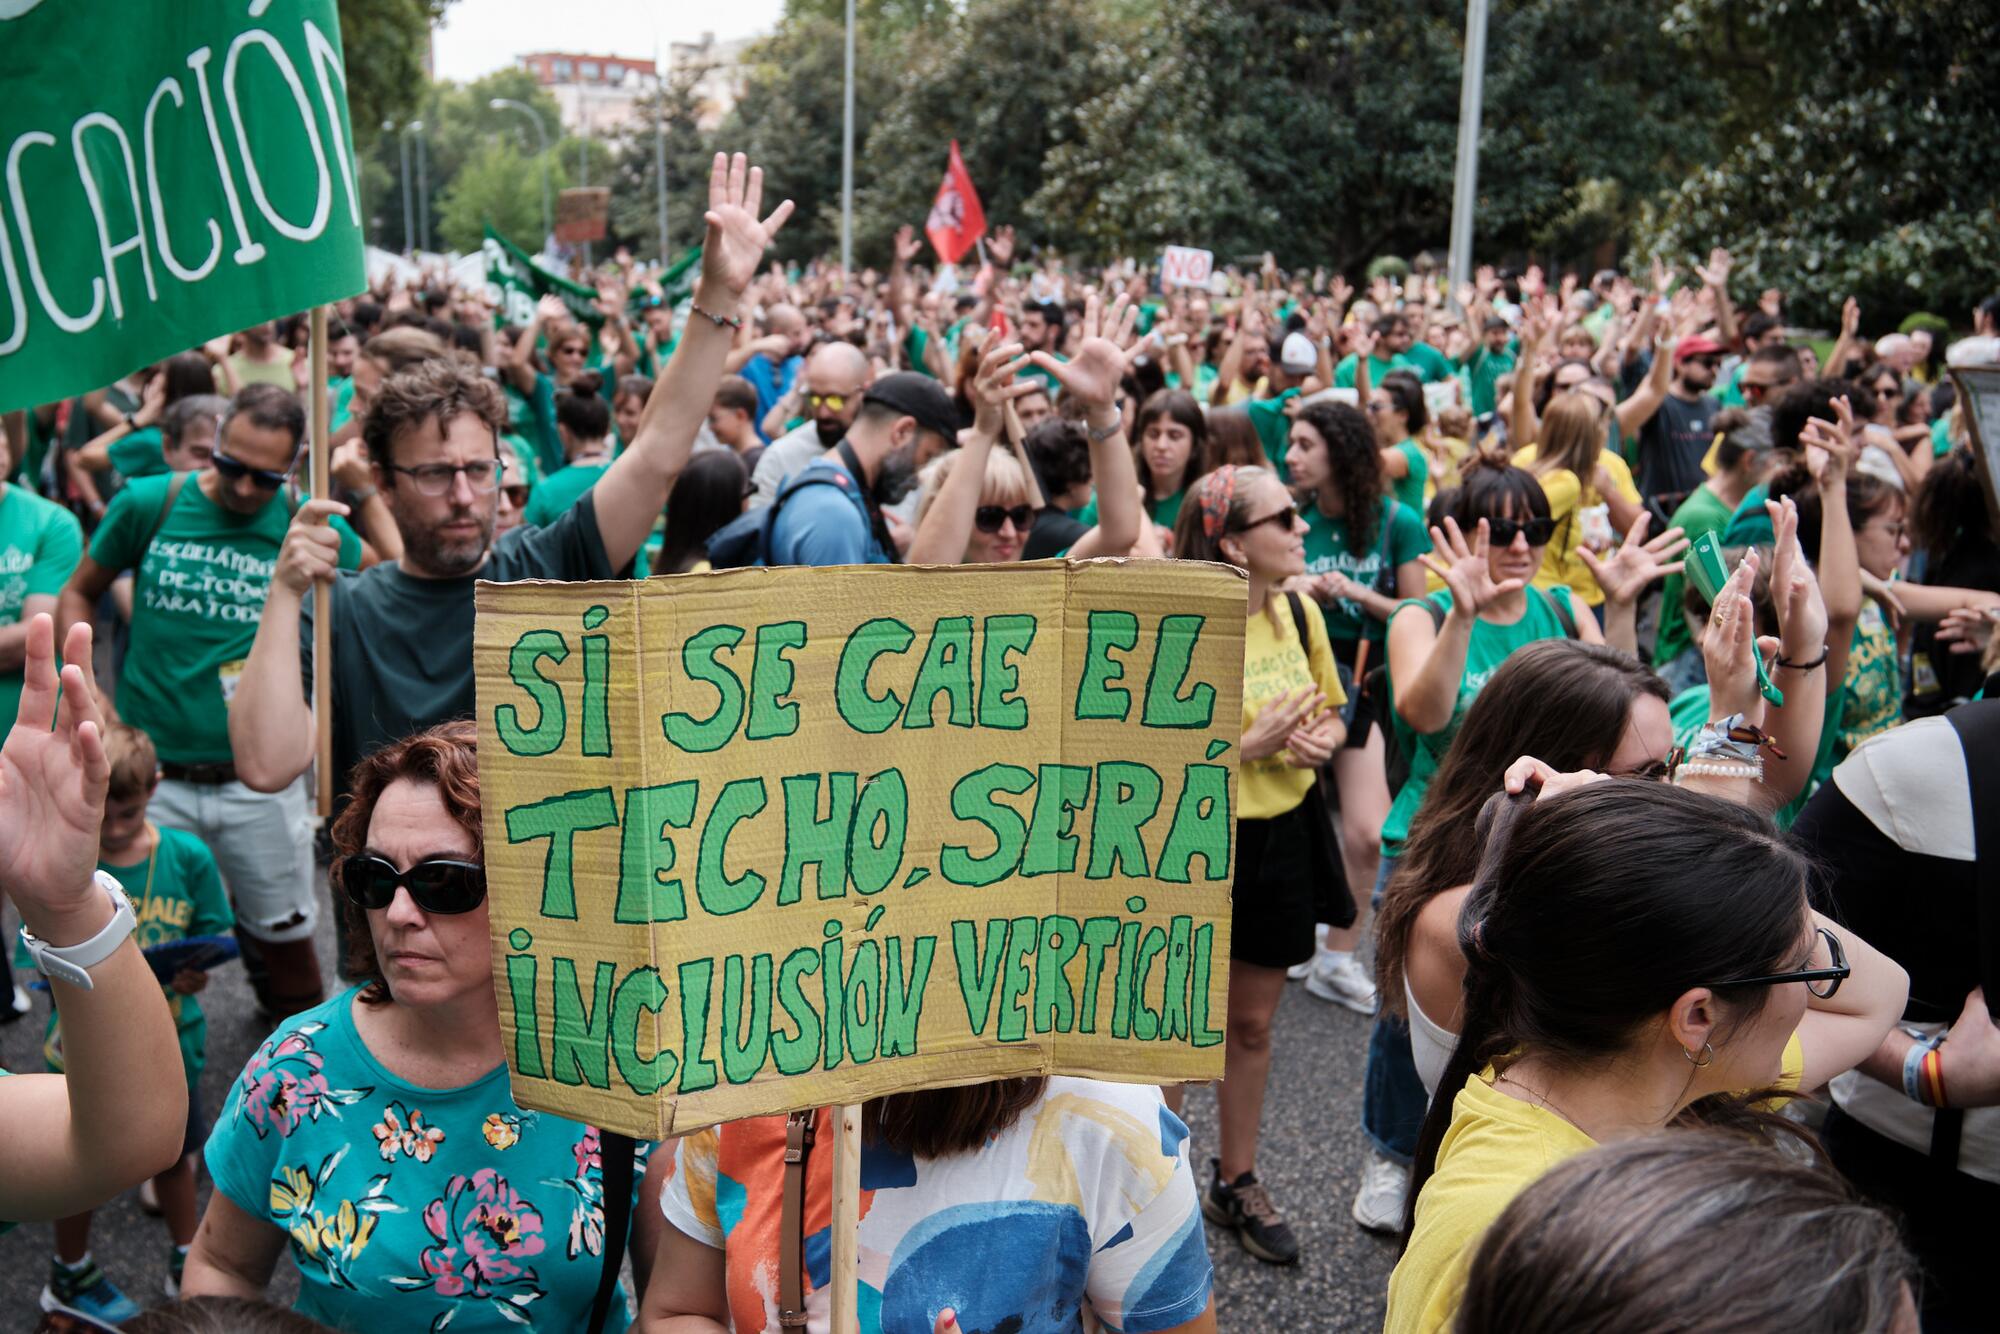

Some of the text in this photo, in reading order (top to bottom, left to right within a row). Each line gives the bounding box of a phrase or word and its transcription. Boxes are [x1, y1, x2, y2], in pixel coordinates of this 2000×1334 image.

[1167, 250, 1208, 282] NO
[158, 570, 190, 590] DE
[661, 620, 808, 753] SE
[835, 614, 1038, 734] CAE
[1074, 610, 1217, 729] EL
[940, 740, 1232, 887] SERÁ
